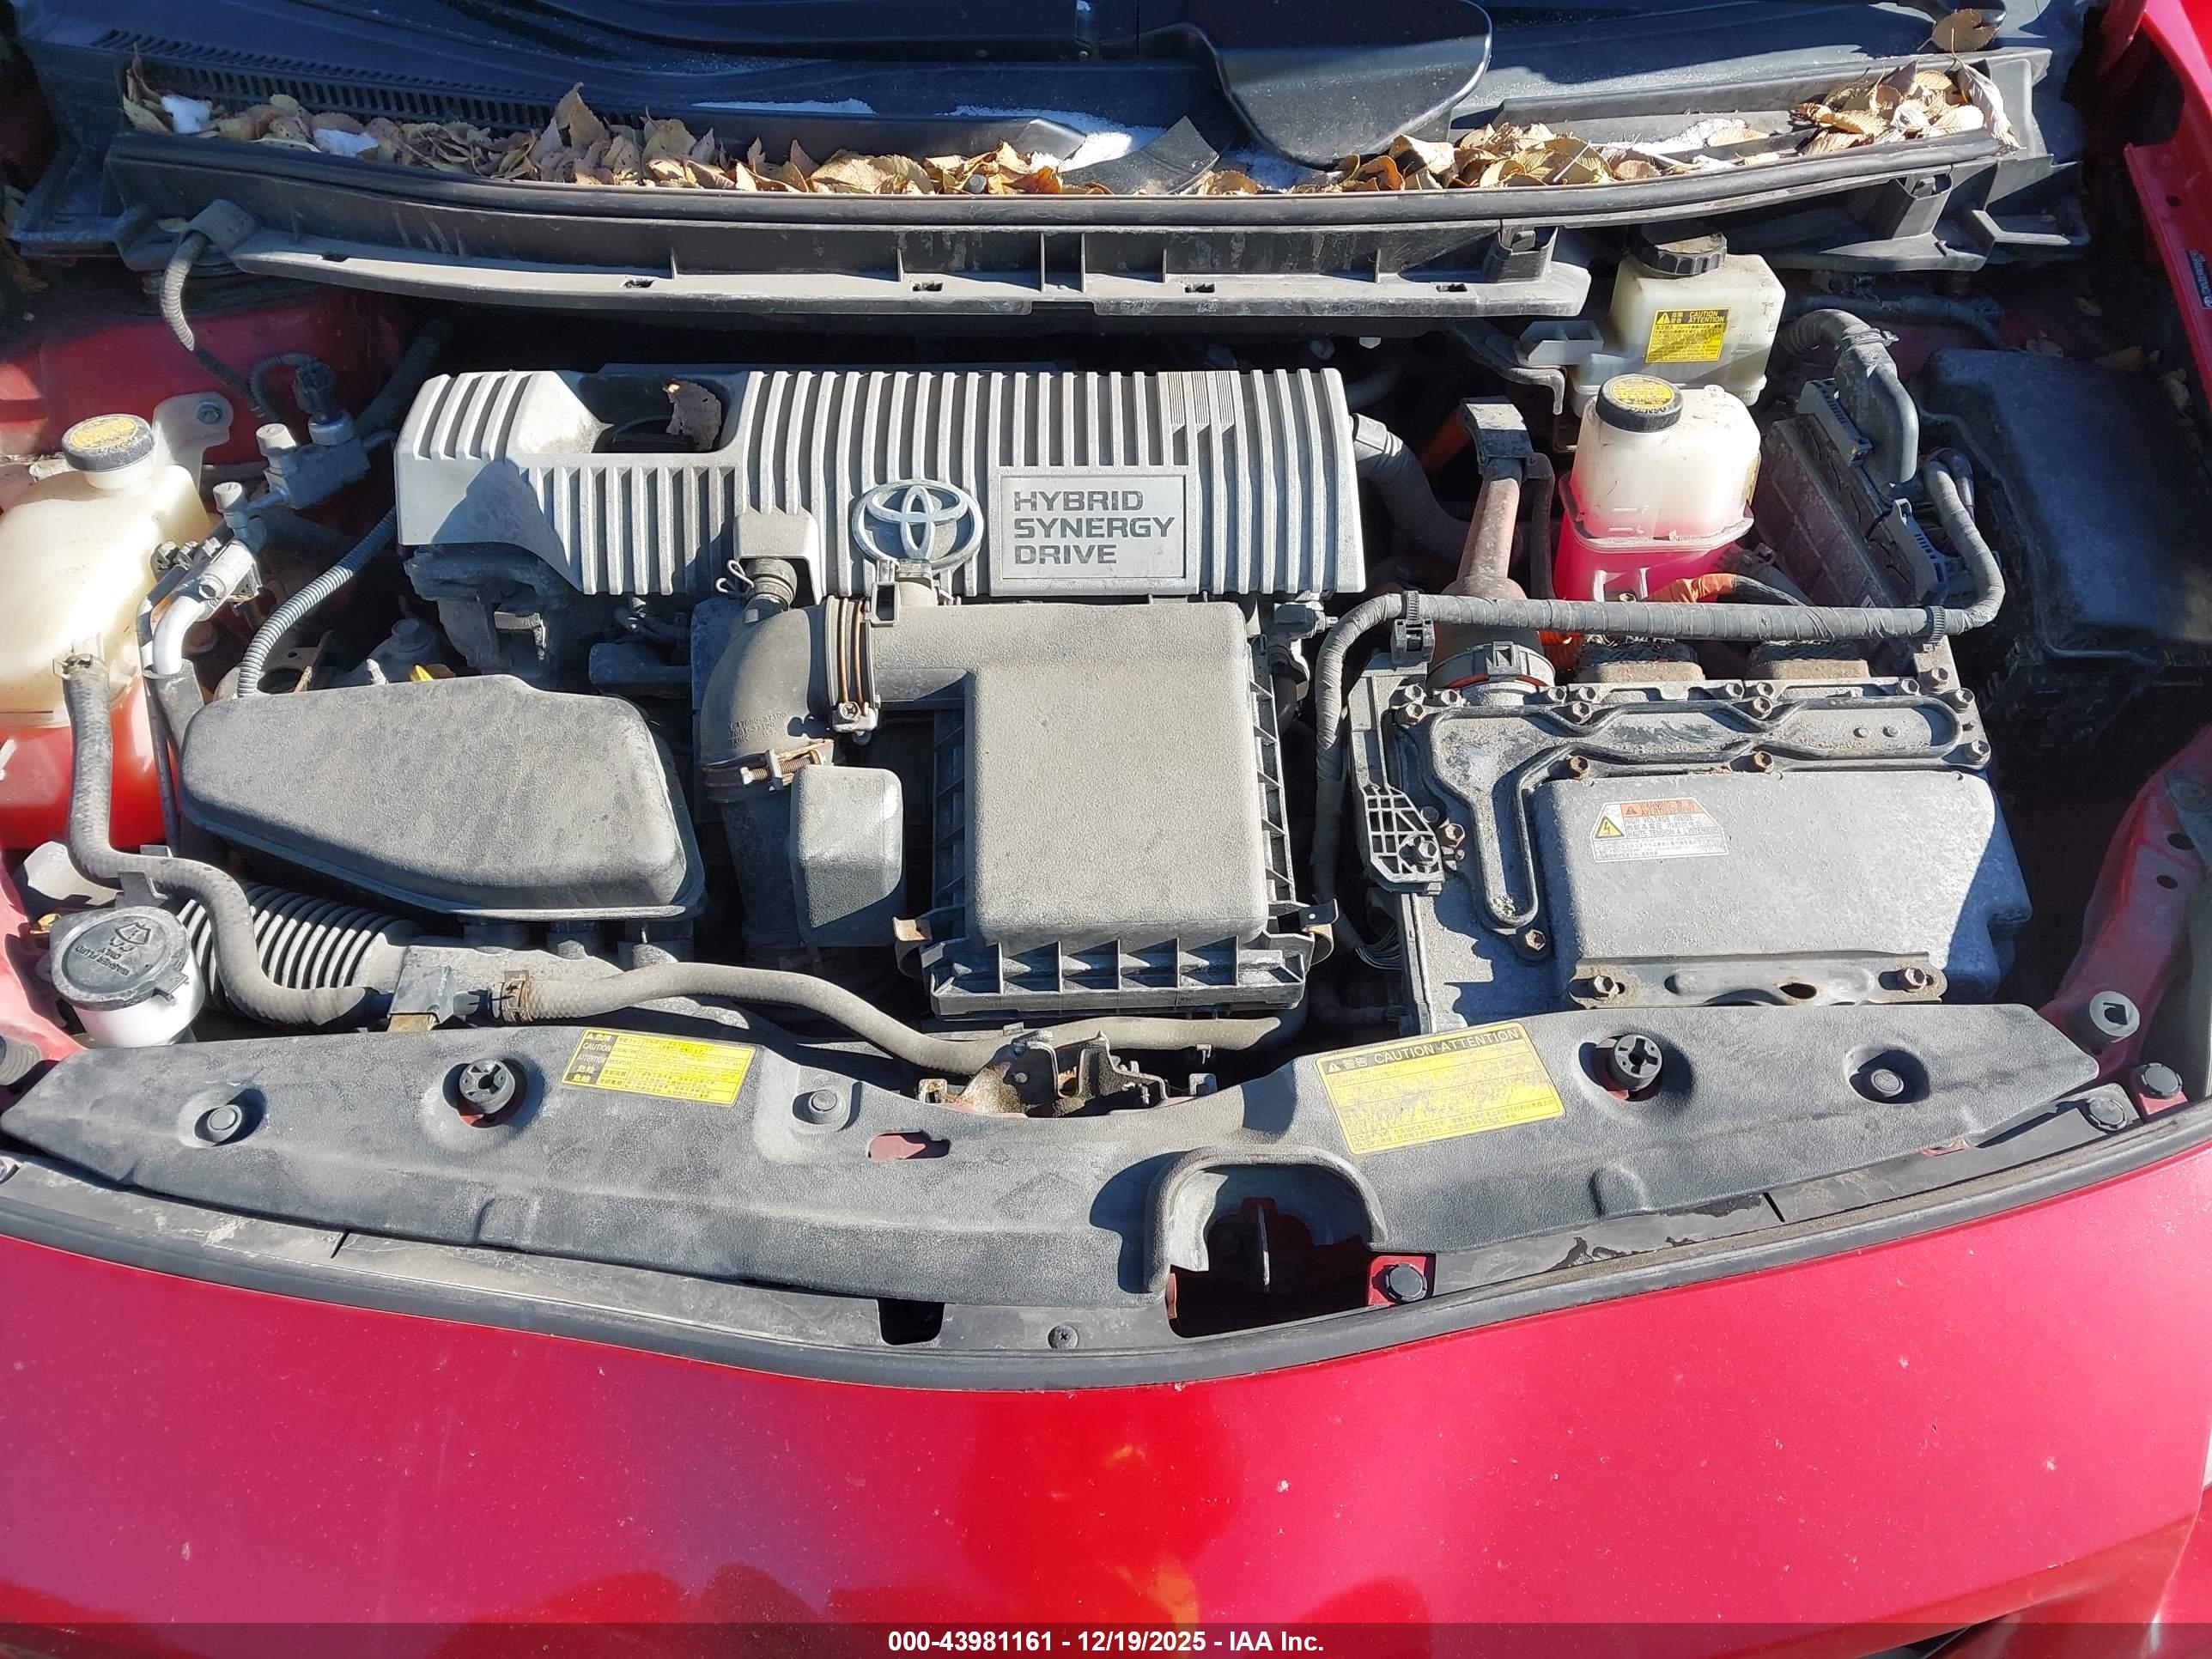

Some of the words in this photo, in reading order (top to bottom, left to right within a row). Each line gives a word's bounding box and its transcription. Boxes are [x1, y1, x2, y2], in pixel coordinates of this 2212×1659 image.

[1014, 490, 1144, 511] HYBRID
[1014, 517, 1176, 538] SYNERGY
[1014, 544, 1117, 564] DRIVE
[582, 1042, 612, 1052] CAUTION
[1374, 1043, 1436, 1064] CAUTION
[1441, 1029, 1519, 1053] ATTENTION
